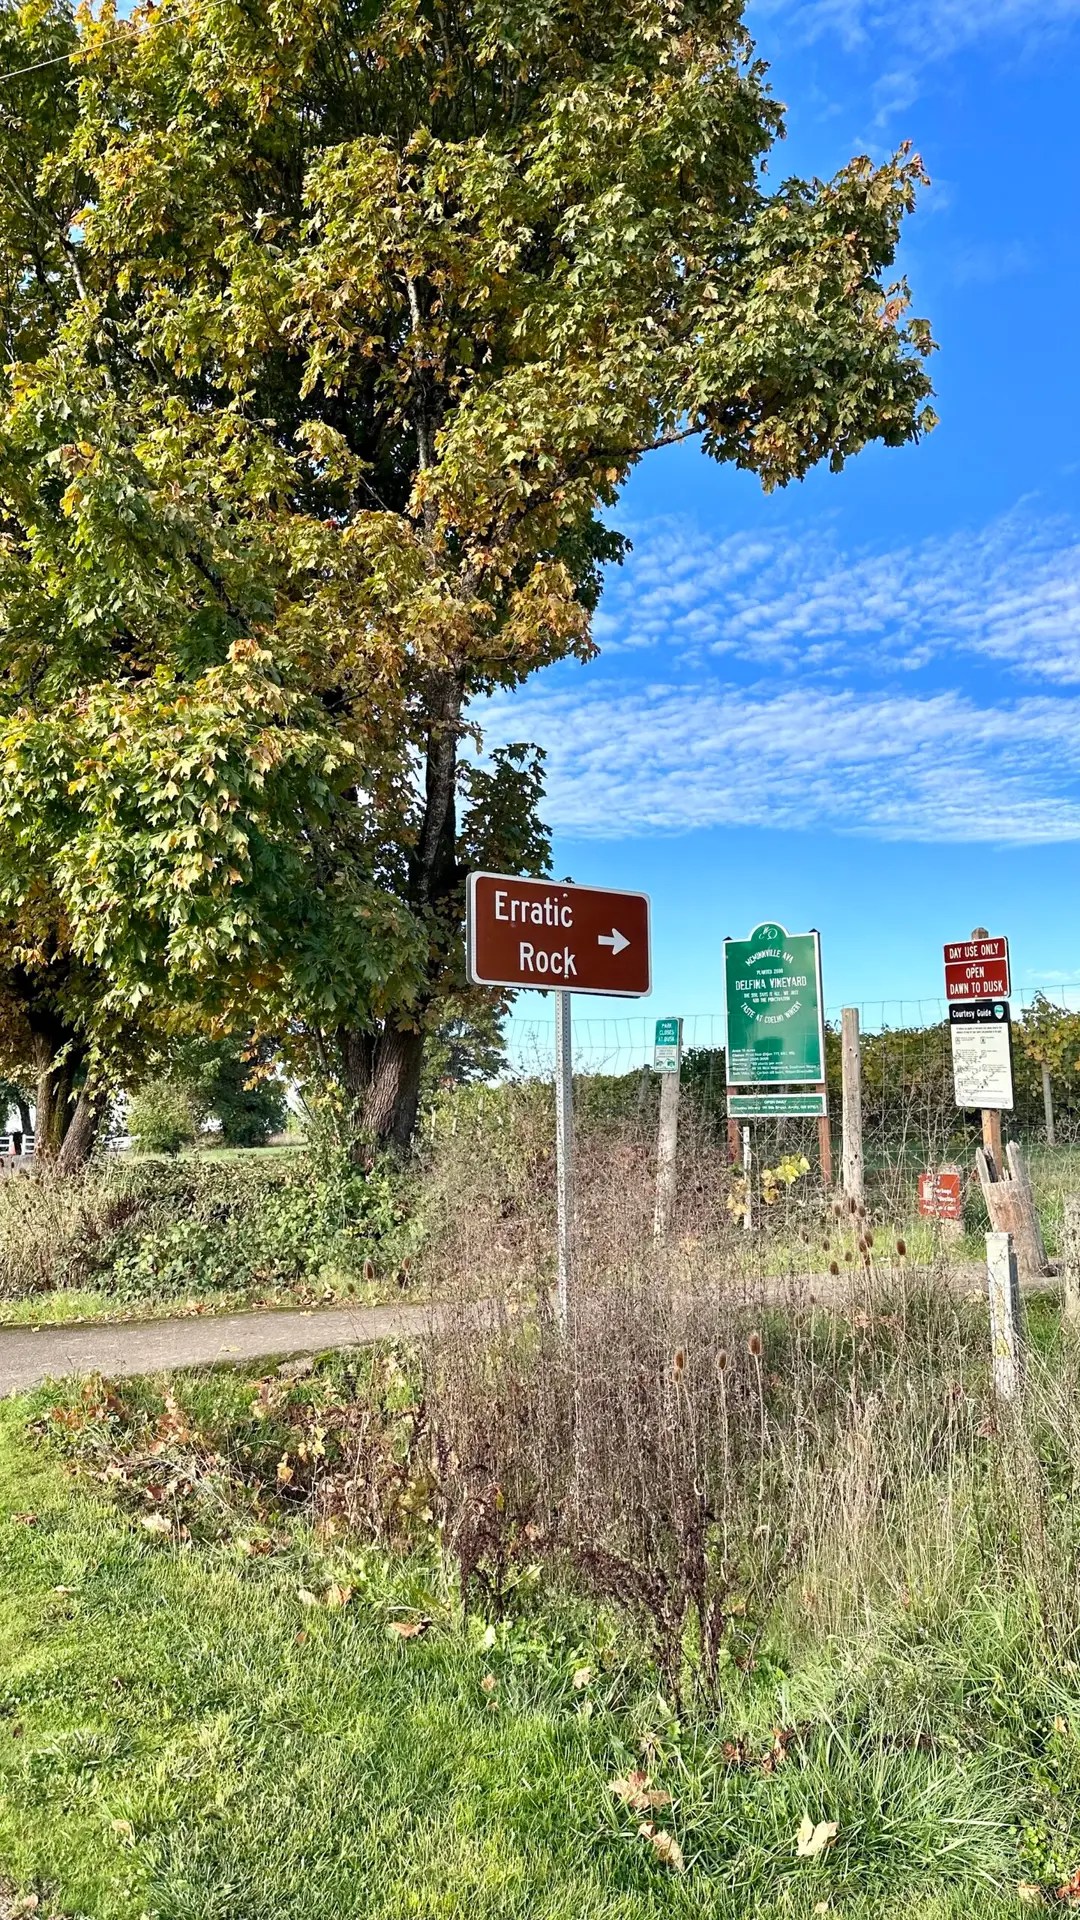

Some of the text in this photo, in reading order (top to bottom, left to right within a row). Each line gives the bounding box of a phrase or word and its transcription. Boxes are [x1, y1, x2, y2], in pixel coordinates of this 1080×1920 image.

[494, 890, 573, 928] Erratic
[519, 941, 578, 976] Rock
[782, 952, 794, 964] AVA
[949, 943, 999, 960] DAY USE ONLY
[965, 966, 985, 979] OPEN
[735, 975, 807, 991] DELFINA VINEYARD
[950, 980, 1004, 995] DAWN TO DUSK
[740, 1002, 756, 1019] TASTE
[755, 1013, 763, 1023] AT
[952, 1010, 975, 1019] Courtesy
[976, 1009, 992, 1017] Guide
